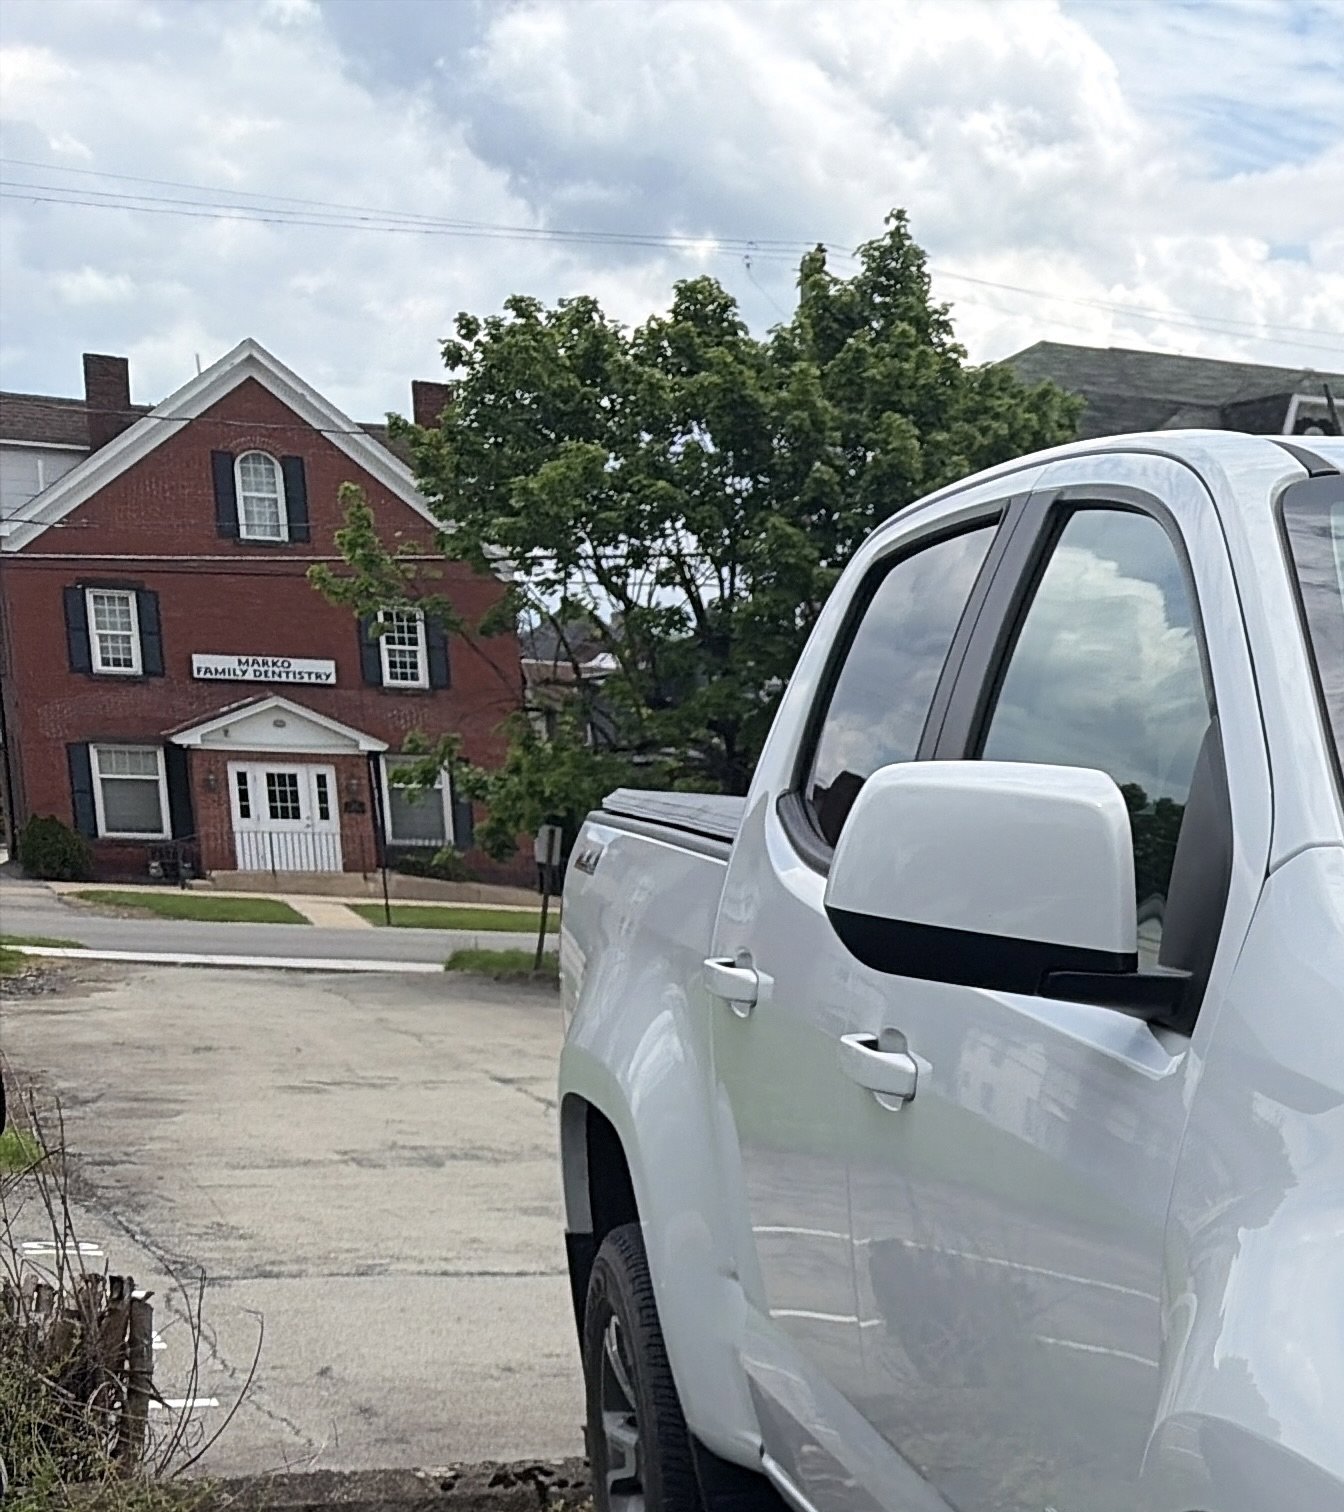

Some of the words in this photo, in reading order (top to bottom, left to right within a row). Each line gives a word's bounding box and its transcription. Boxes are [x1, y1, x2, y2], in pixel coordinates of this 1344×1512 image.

[237, 658, 292, 669] MARKO
[196, 666, 249, 678] FAMILY
[253, 669, 332, 681] DENTISTRY
